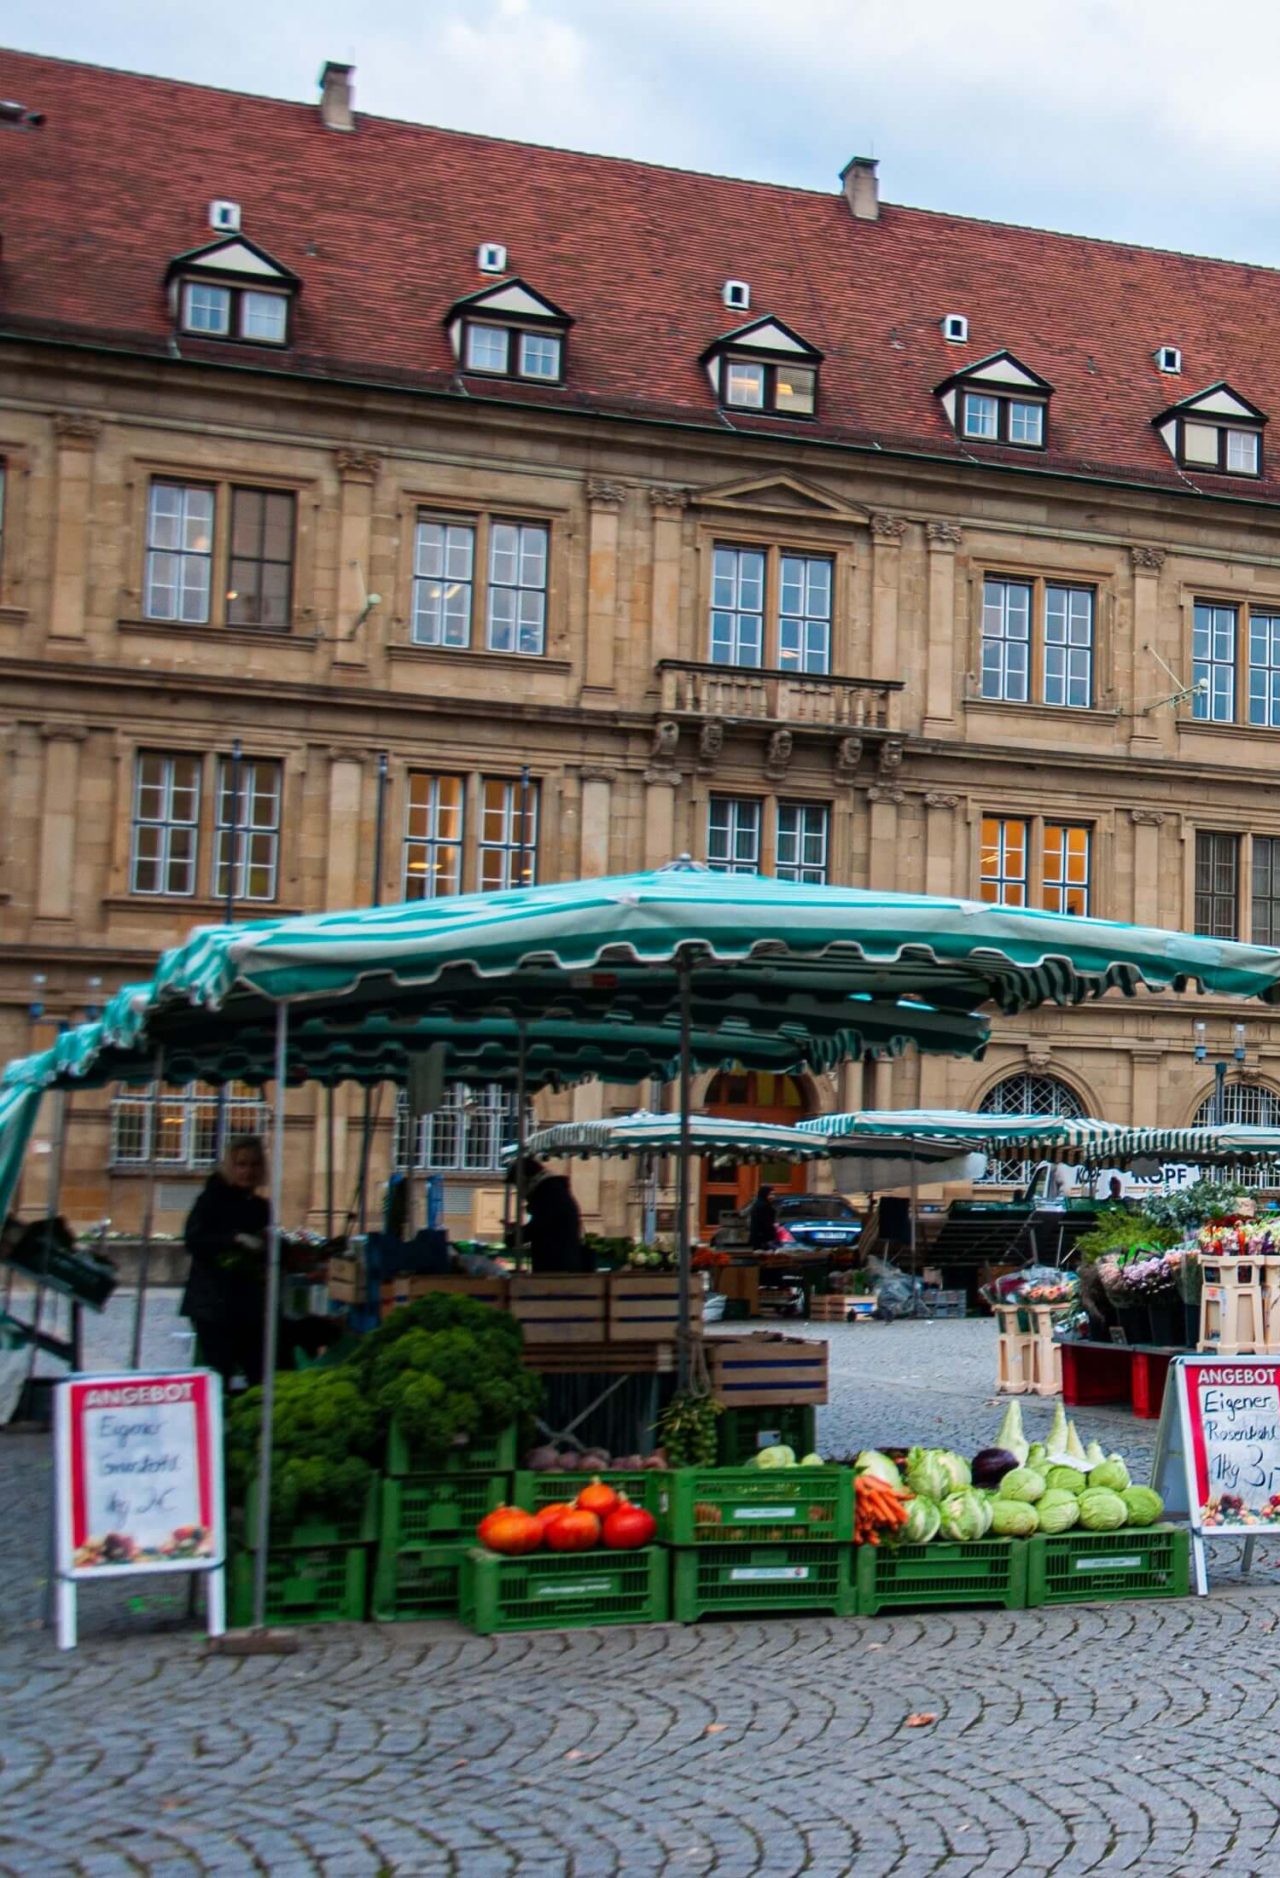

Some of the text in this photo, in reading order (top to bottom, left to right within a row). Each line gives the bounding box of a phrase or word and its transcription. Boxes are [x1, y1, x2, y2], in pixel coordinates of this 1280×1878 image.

[1198, 1368, 1276, 1385] ANGEBOT
[84, 1382, 195, 1407] ANGEBOT
[1204, 1390, 1272, 1422] Eigener
[1206, 1420, 1276, 1441] Rosenkohl
[1211, 1453, 1240, 1489] 1kg
